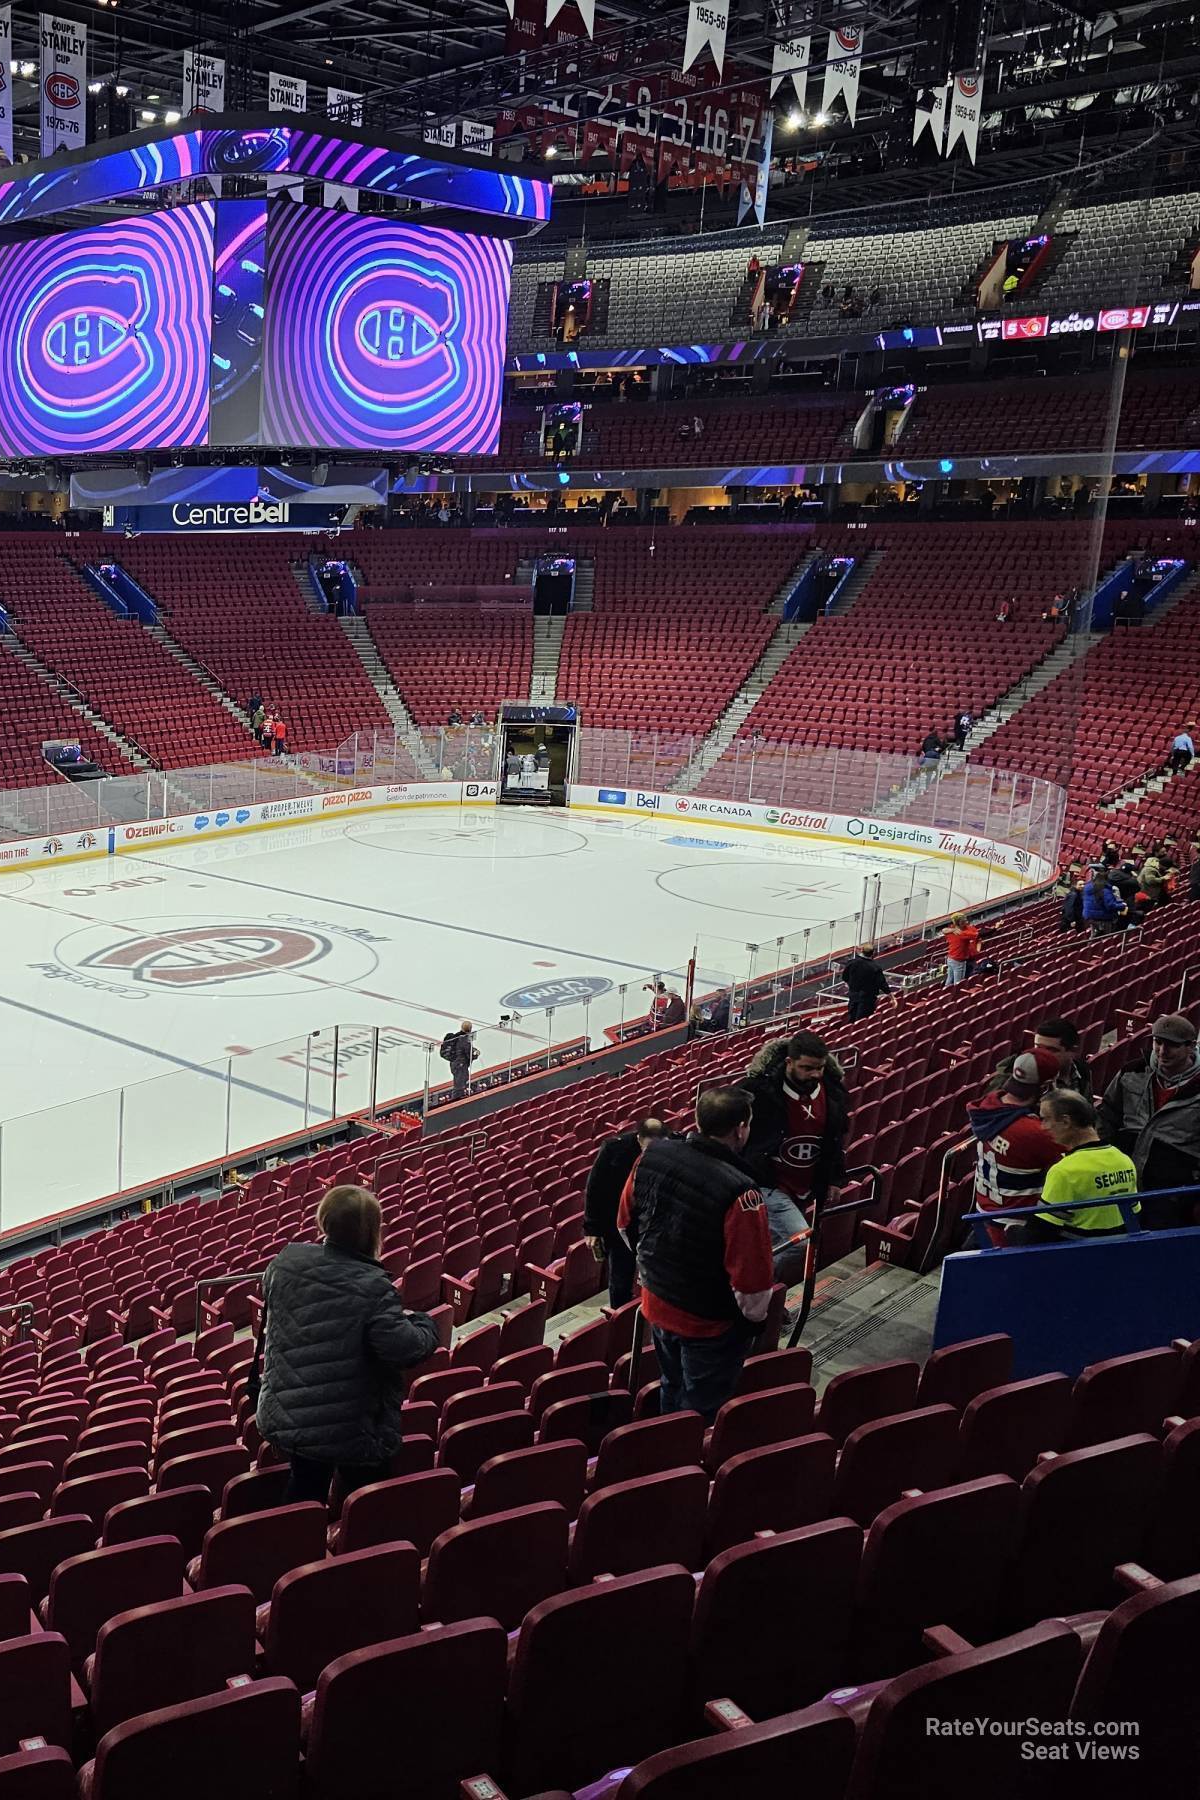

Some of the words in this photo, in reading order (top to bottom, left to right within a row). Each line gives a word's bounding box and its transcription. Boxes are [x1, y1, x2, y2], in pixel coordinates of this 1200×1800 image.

[514, 18, 536, 36] PLANTE
[696, 7, 726, 30] 1955-56
[51, 21, 76, 35] COUPE
[41, 31, 86, 56] STANLEY
[55, 54, 71, 64] CUP
[194, 58, 215, 71] COUPE
[185, 68, 223, 89] STANLEY
[832, 62, 857, 78] 1957-58
[278, 78, 298, 89] COUPE
[270, 88, 304, 109] STANLEY
[636, 86, 652, 136] 9
[672, 98, 688, 142] 3
[954, 104, 976, 122] 1959-60
[45, 116, 80, 134] 1975-76
[470, 126, 486, 136] COUPE
[702, 104, 728, 156] 16
[742, 116, 756, 163] 7
[1050, 318, 1094, 334] 20:00
[1132, 312, 1142, 323] 2
[984, 329, 998, 338] 22
[1007, 324, 1017, 335] 5
[172, 502, 289, 526] CentreBell
[322, 794, 346, 810] pizza
[348, 790, 372, 806] pizza
[636, 793, 660, 809] Bell
[692, 803, 708, 812] AIR
[709, 804, 752, 818] CANADA
[780, 811, 828, 830] Castrol
[868, 824, 932, 844] Desjardins
[14, 848, 29, 857] TIRE
[938, 832, 960, 851] Tim
[962, 837, 1006, 864] Hortons
[105, 876, 168, 893] CIBC
[267, 912, 392, 944] CentreBell
[27, 962, 150, 1000] CentreBell
[518, 978, 594, 1004] Ford
[880, 1240, 891, 1253] M
[454, 1289, 460, 1299] H
[540, 1281, 545, 1290] J
